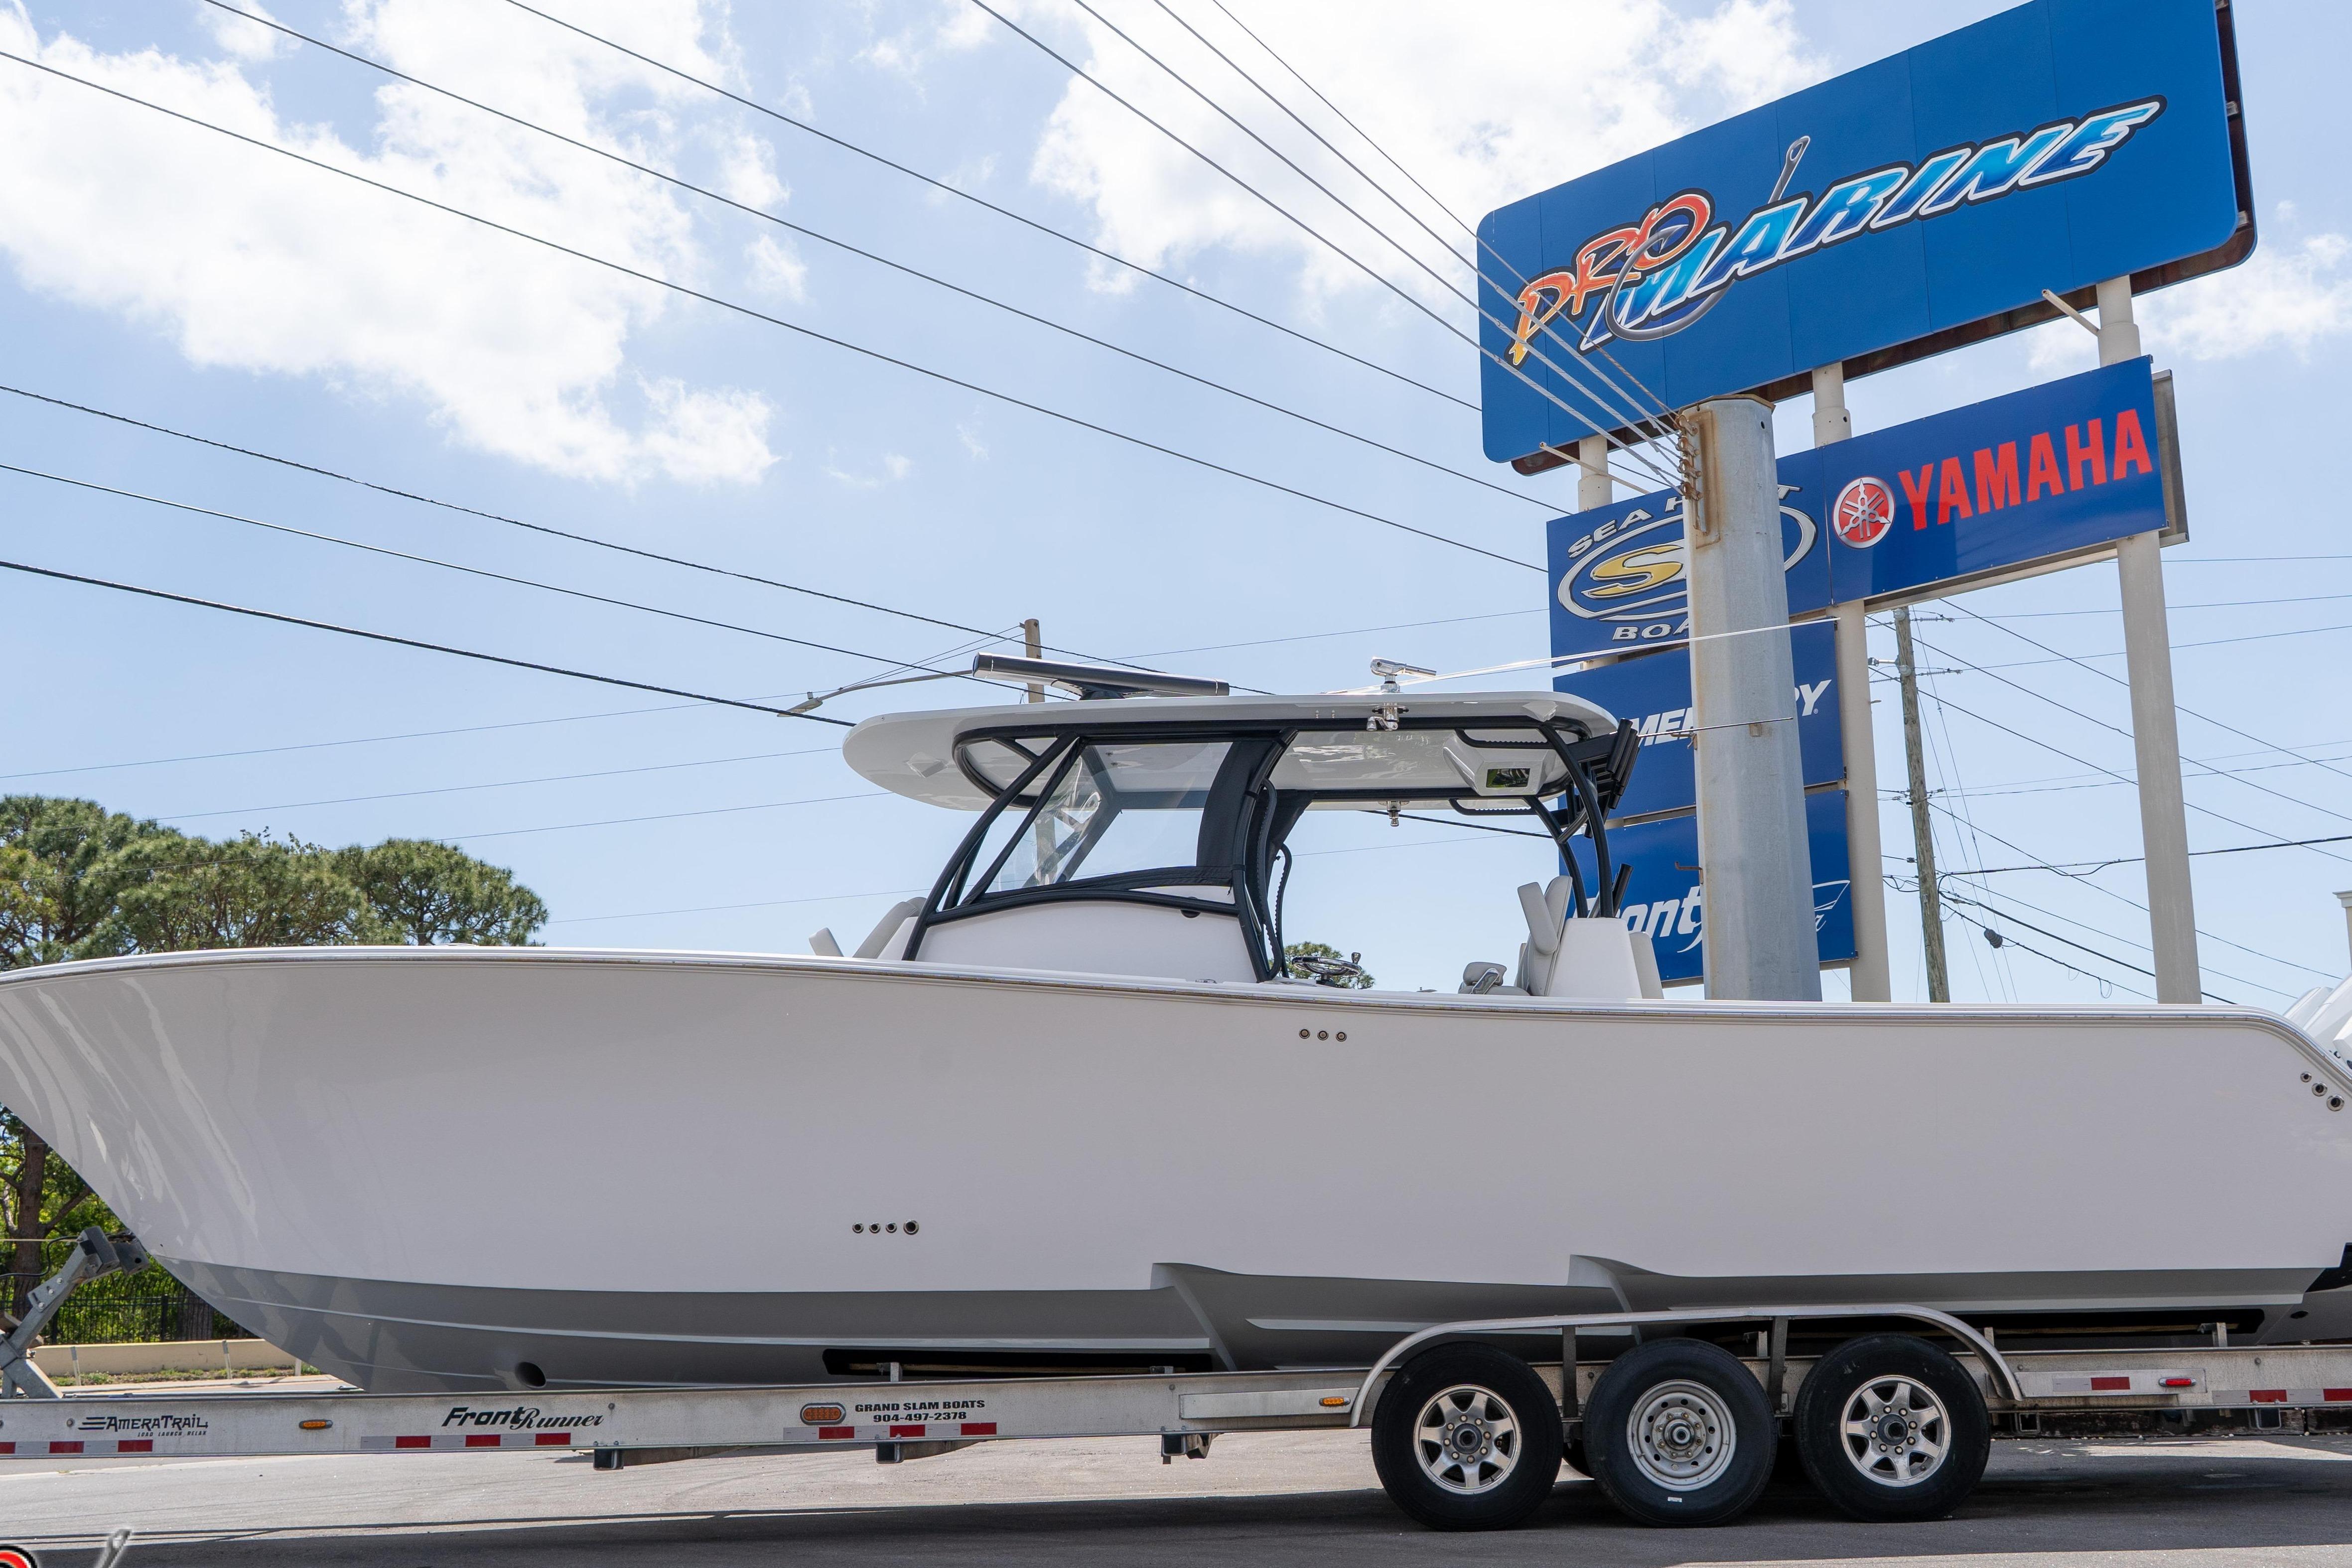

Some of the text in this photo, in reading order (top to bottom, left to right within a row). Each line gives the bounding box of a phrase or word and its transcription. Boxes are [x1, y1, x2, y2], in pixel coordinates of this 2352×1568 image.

[1579, 101, 2161, 351] MARINE
[1509, 193, 1711, 366] PRO
[1898, 408, 2153, 531] YAMAHA
[1568, 508, 1653, 558] SEA
[855, 1400, 985, 1412] GRAND SLAM BOATS
[873, 1411, 967, 1423] 904-497-2378
